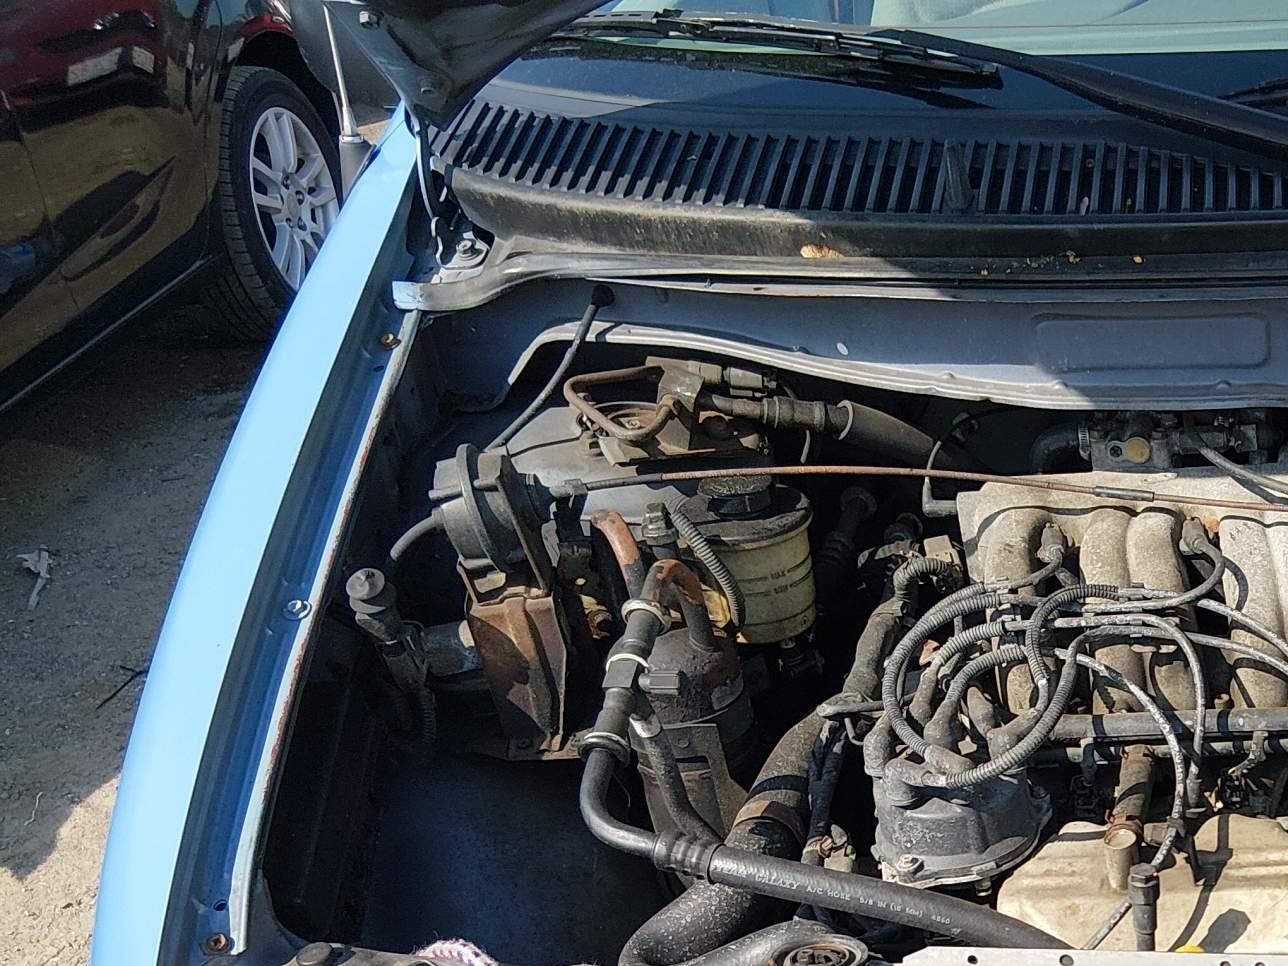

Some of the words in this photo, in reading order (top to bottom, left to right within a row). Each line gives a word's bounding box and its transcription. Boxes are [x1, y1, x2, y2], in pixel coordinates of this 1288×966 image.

[755, 874, 801, 890] GALAXY
[806, 886, 824, 895] A/C
[827, 890, 851, 901] HOSE
